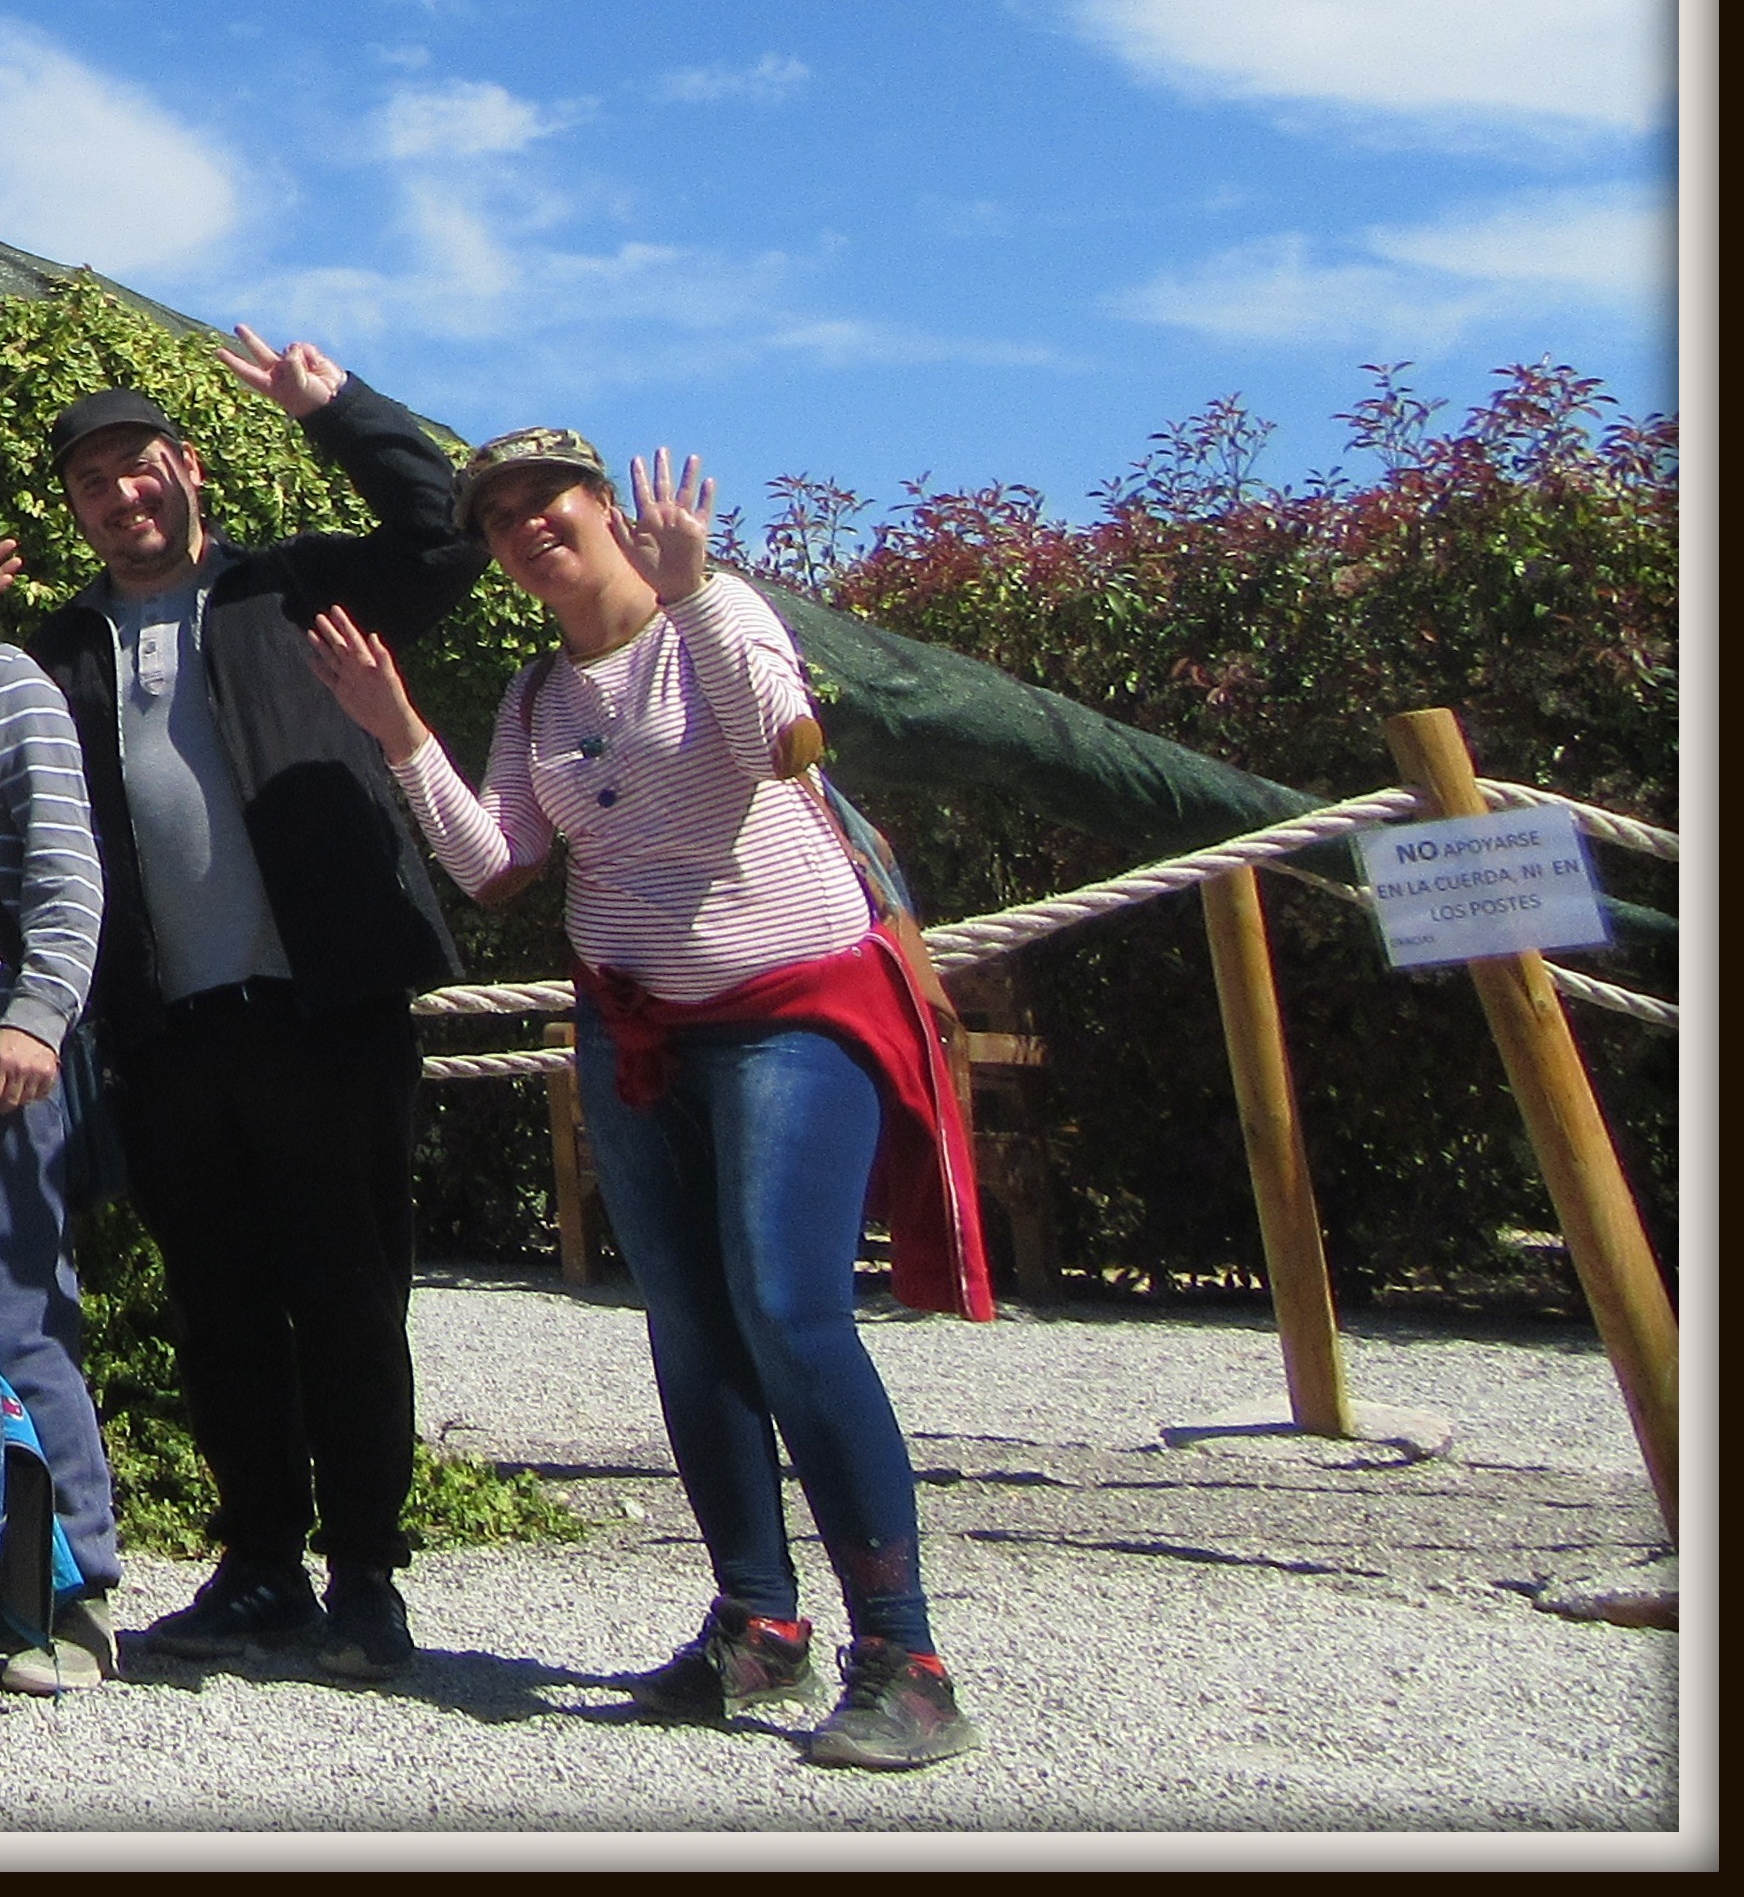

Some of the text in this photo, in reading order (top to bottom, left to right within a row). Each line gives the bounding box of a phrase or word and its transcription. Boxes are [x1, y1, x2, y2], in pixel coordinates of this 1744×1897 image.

[1395, 830, 1540, 864] NO APOYARSE
[1377, 859, 1580, 899] EN LA CUERDA, NI EN
[1431, 895, 1541, 922] LOS POSTES
